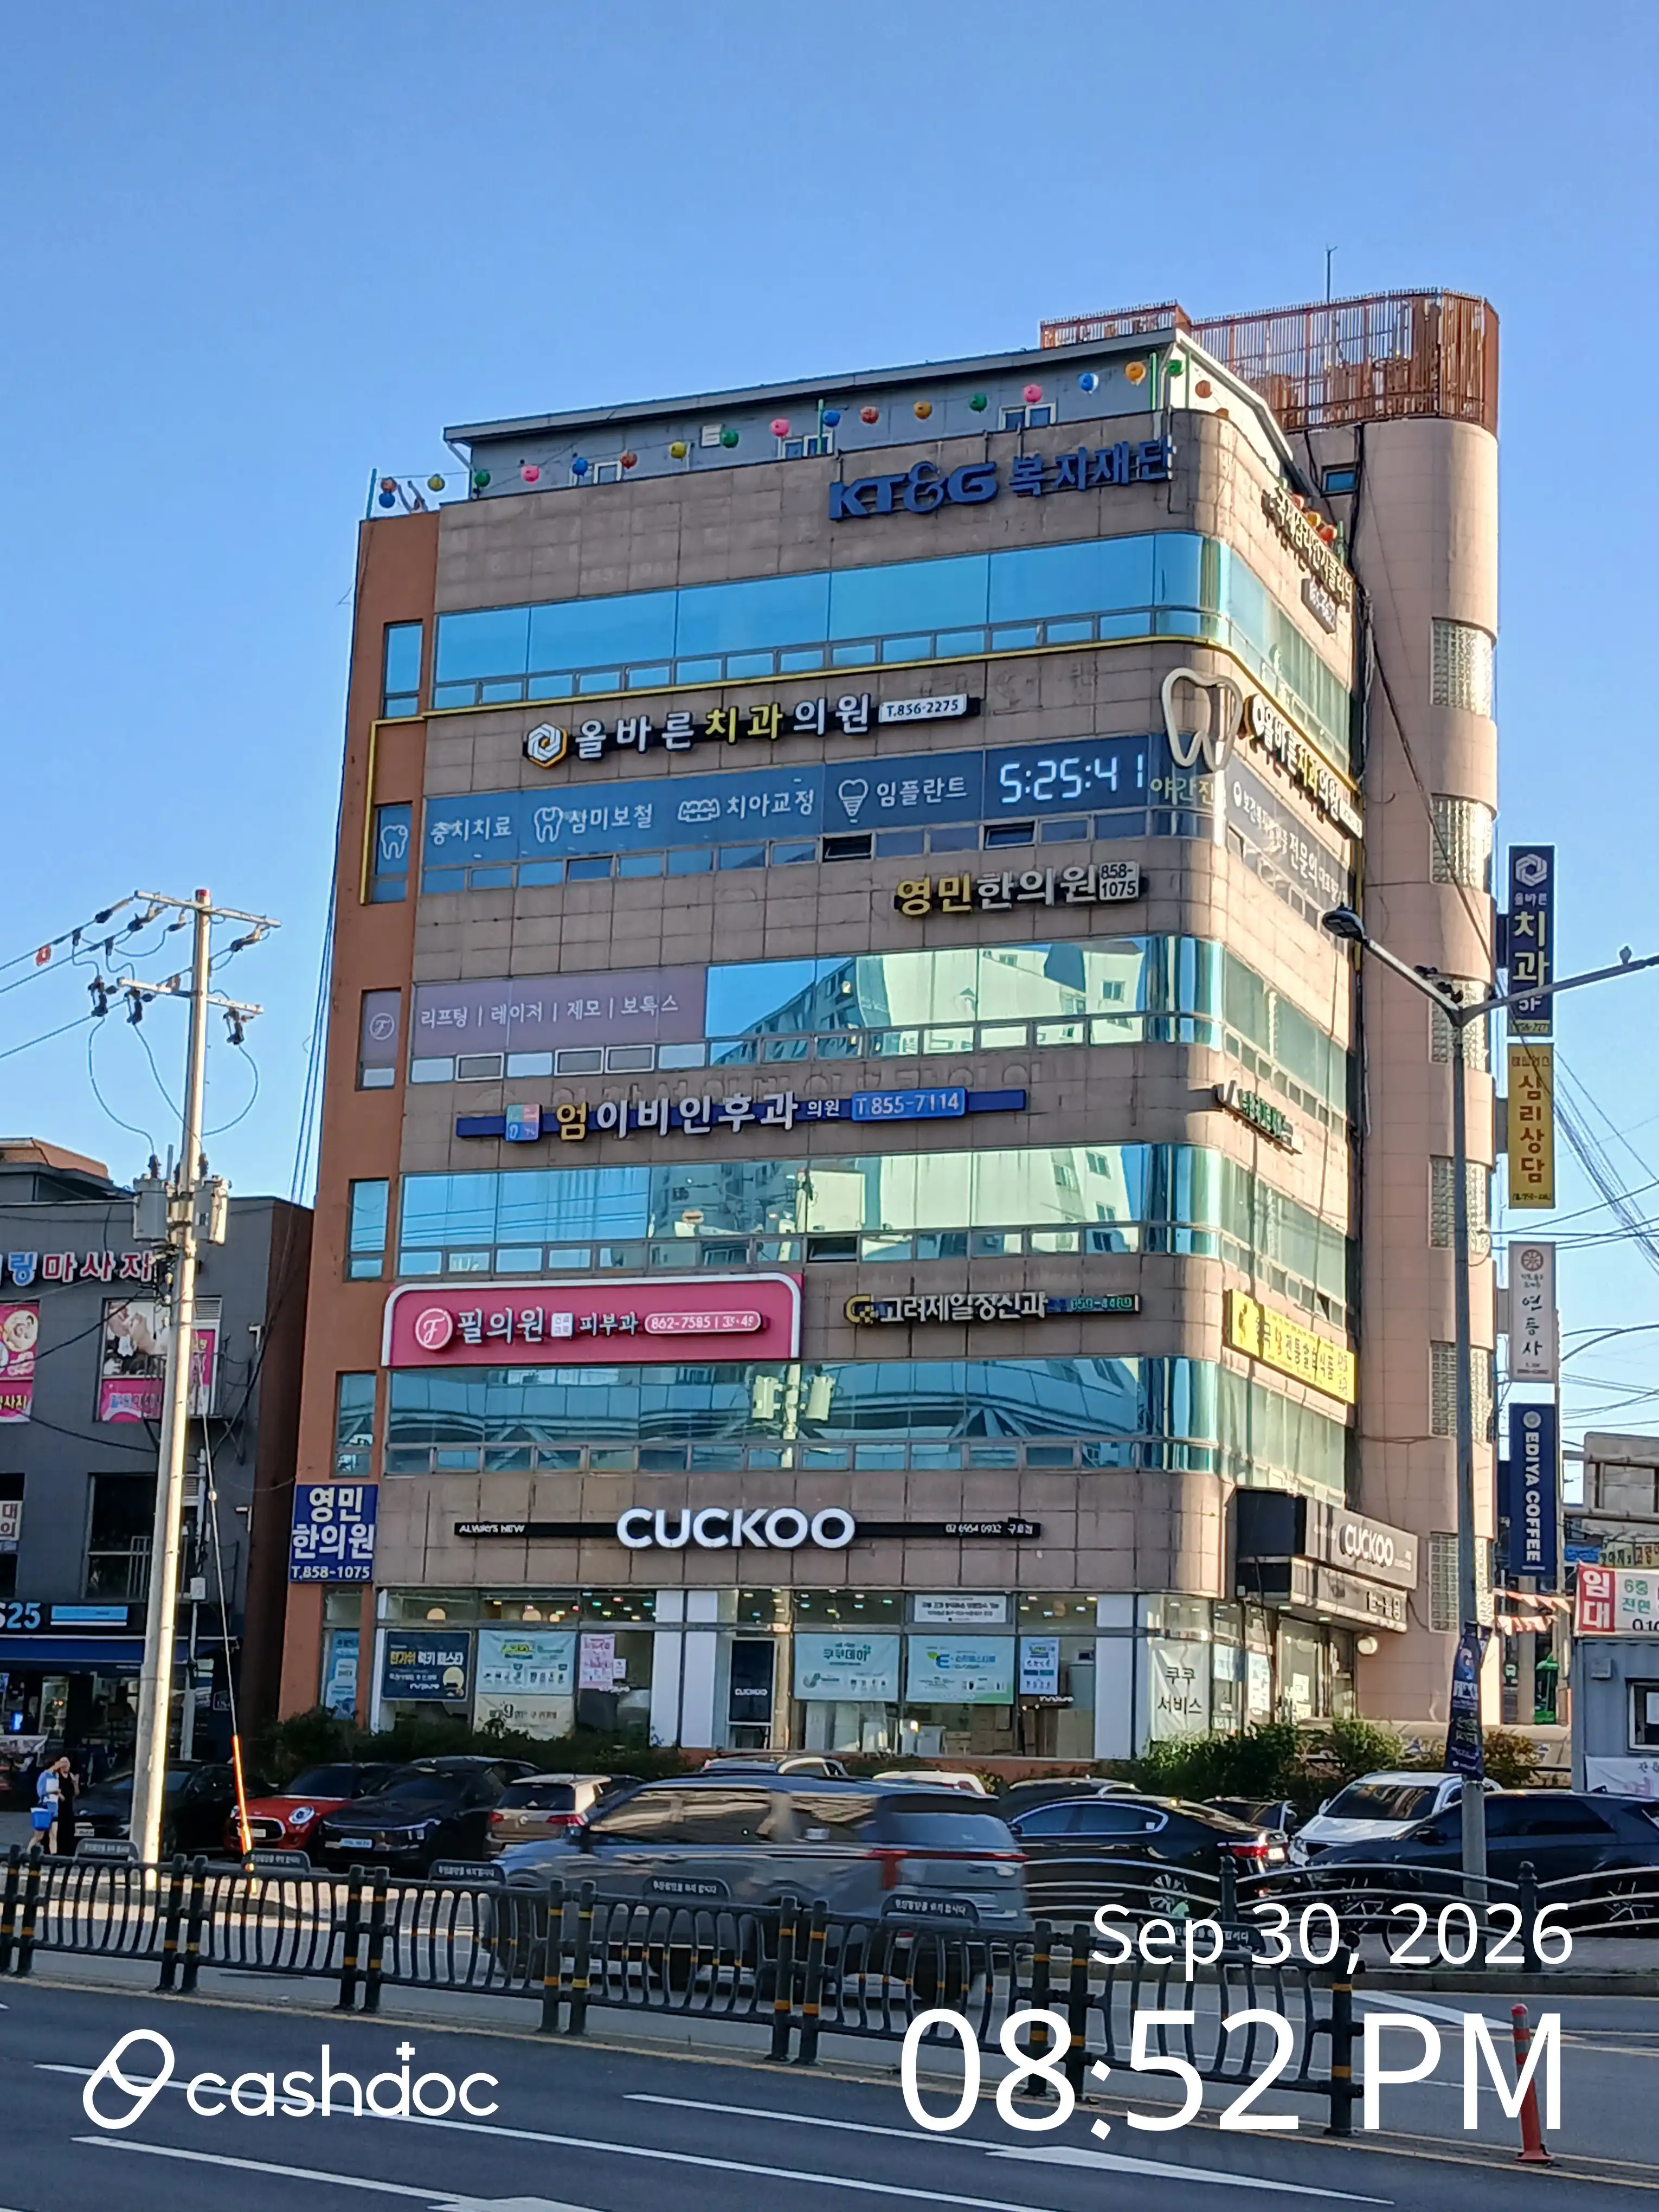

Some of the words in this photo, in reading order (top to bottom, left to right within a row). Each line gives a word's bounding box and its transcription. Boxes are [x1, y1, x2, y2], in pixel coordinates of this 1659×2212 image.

[829, 460, 998, 520] KT&G
[1009, 435, 1176, 497] 복지재단
[886, 699, 959, 718] T.856-2275
[1000, 754, 1143, 804] 5:25:41
[430, 815, 512, 846] 충치치료
[727, 789, 814, 819] 치아교정
[876, 775, 969, 808] 임플란트
[897, 864, 1096, 916] 영민한의원
[1101, 864, 1133, 879] 858-
[1101, 881, 1136, 898] 1075
[1512, 911, 1549, 989] 치과
[421, 1006, 468, 1028] 리프팅
[491, 1001, 542, 1026] 레이저
[567, 998, 601, 1020] 제모
[621, 995, 678, 1016] 보톡스
[556, 1091, 798, 1140] 엄이비인후과
[807, 1099, 840, 1117] 의원
[870, 1092, 959, 1115] 855-7114
[1518, 1075, 1545, 1184] 심리상담
[0, 1251, 155, 1286] 링마사지
[457, 1306, 545, 1345] 필의원
[580, 1311, 639, 1336] 피부과
[651, 1315, 710, 1330] 862-7585
[879, 1291, 1049, 1323] 고려제일정신과
[1525, 1432, 1540, 1487] EDIYA
[308, 1487, 363, 1522] 영민
[292, 1523, 375, 1561] 한의원
[616, 1507, 856, 1549] CUCKOO
[1342, 1523, 1394, 1567] CUCKOO
[1526, 1490, 1541, 1562] COFFEE
[291, 1565, 370, 1580] T.858-1075
[1582, 1570, 1610, 1629] 임대
[1165, 1666, 1197, 1684] 쿠쿠
[1158, 1696, 1203, 1715] 서비스
